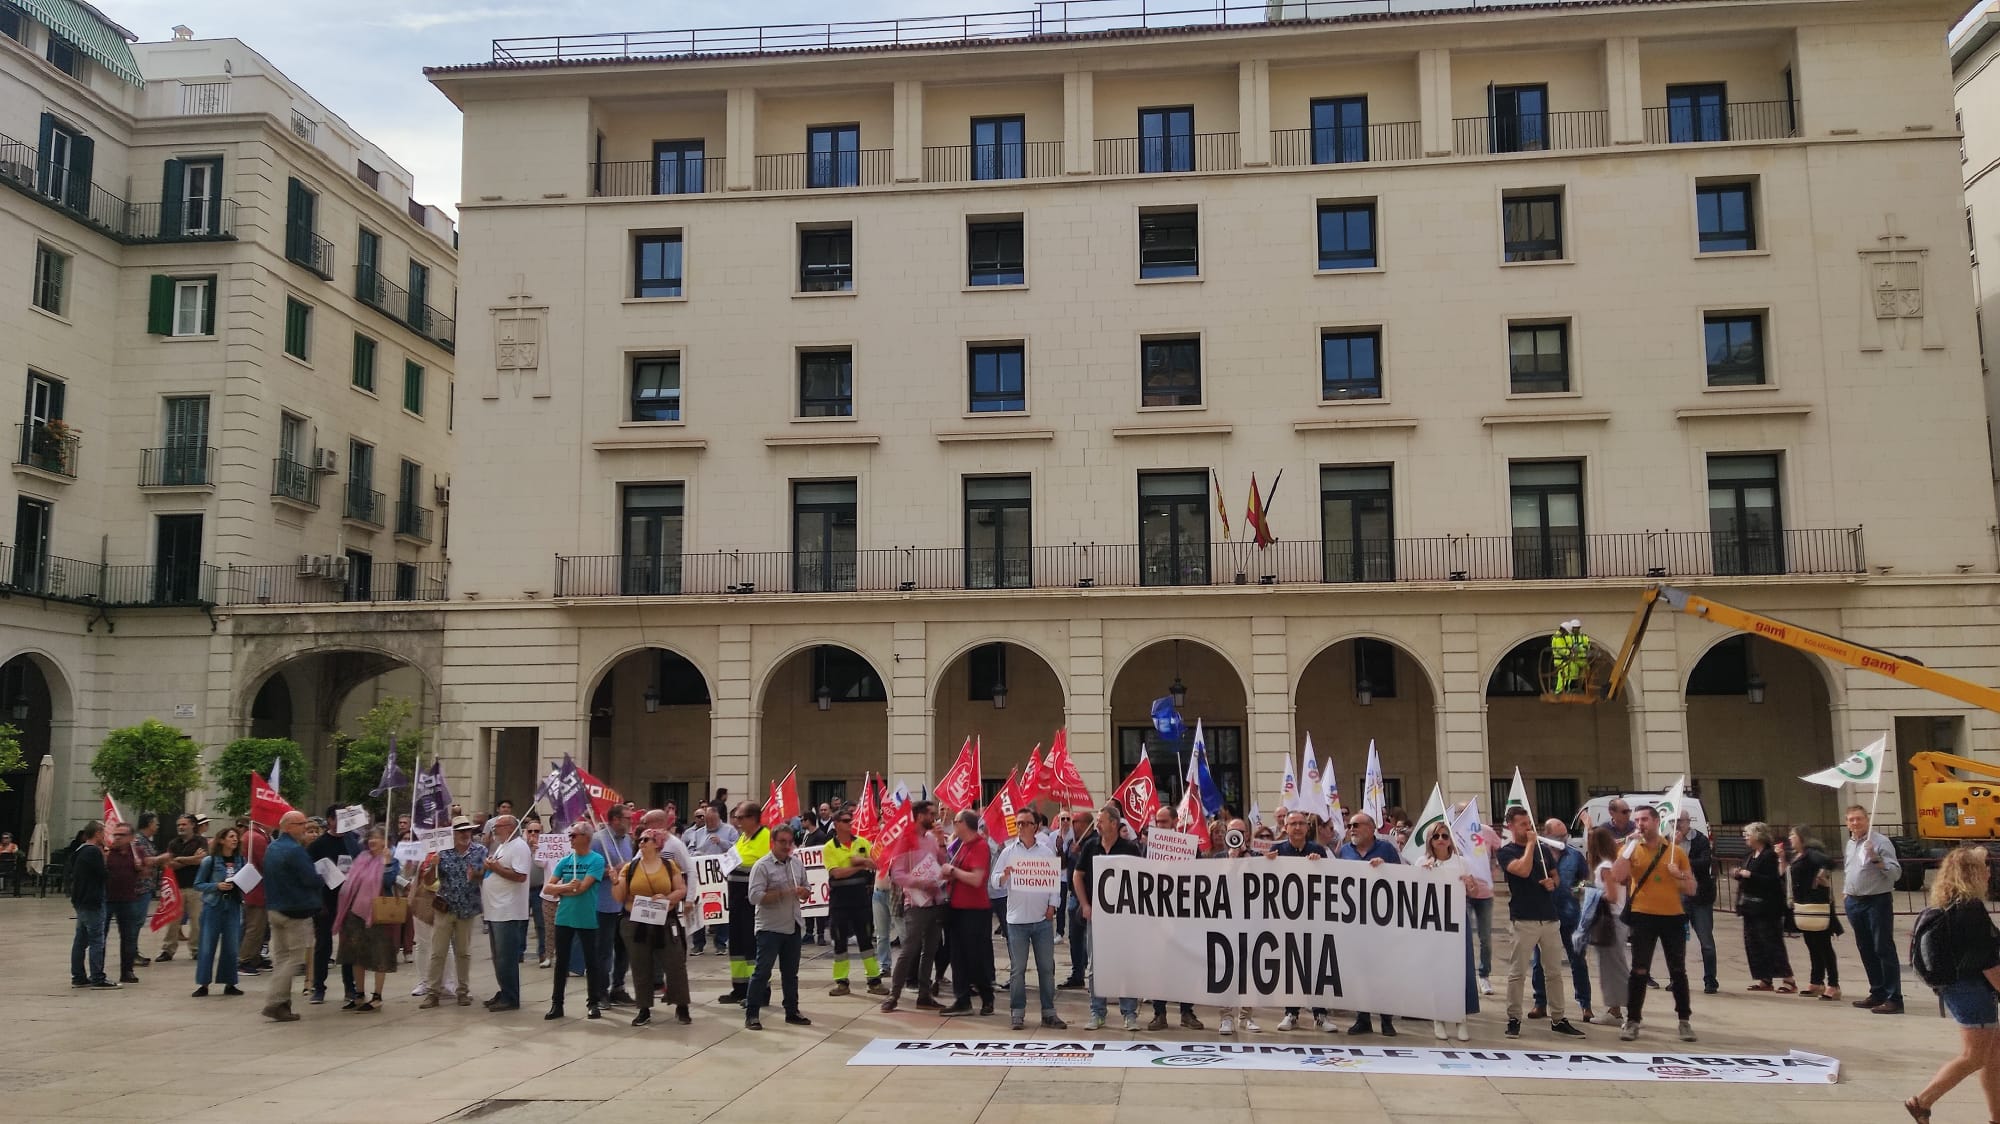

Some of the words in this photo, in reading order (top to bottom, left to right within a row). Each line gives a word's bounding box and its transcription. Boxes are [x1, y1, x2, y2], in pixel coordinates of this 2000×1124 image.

[1803, 638, 1848, 657] SOLUCIONES
[538, 836, 569, 844] BARCAL
[1148, 841, 1196, 856] PROFESIONAL
[1153, 833, 1188, 845] CARRERA
[538, 850, 570, 859] ENGAÑ
[696, 858, 728, 886] LAB
[1097, 868, 1233, 919] CARRERA
[1244, 872, 1459, 932] PROFESIONAL
[1206, 930, 1344, 998] DIGNA
[894, 1041, 1165, 1053] BARCALA
[1180, 1044, 1420, 1060] CUMPLE
[1429, 1050, 1512, 1061] TU
[1524, 1053, 1832, 1068] PALABRA
